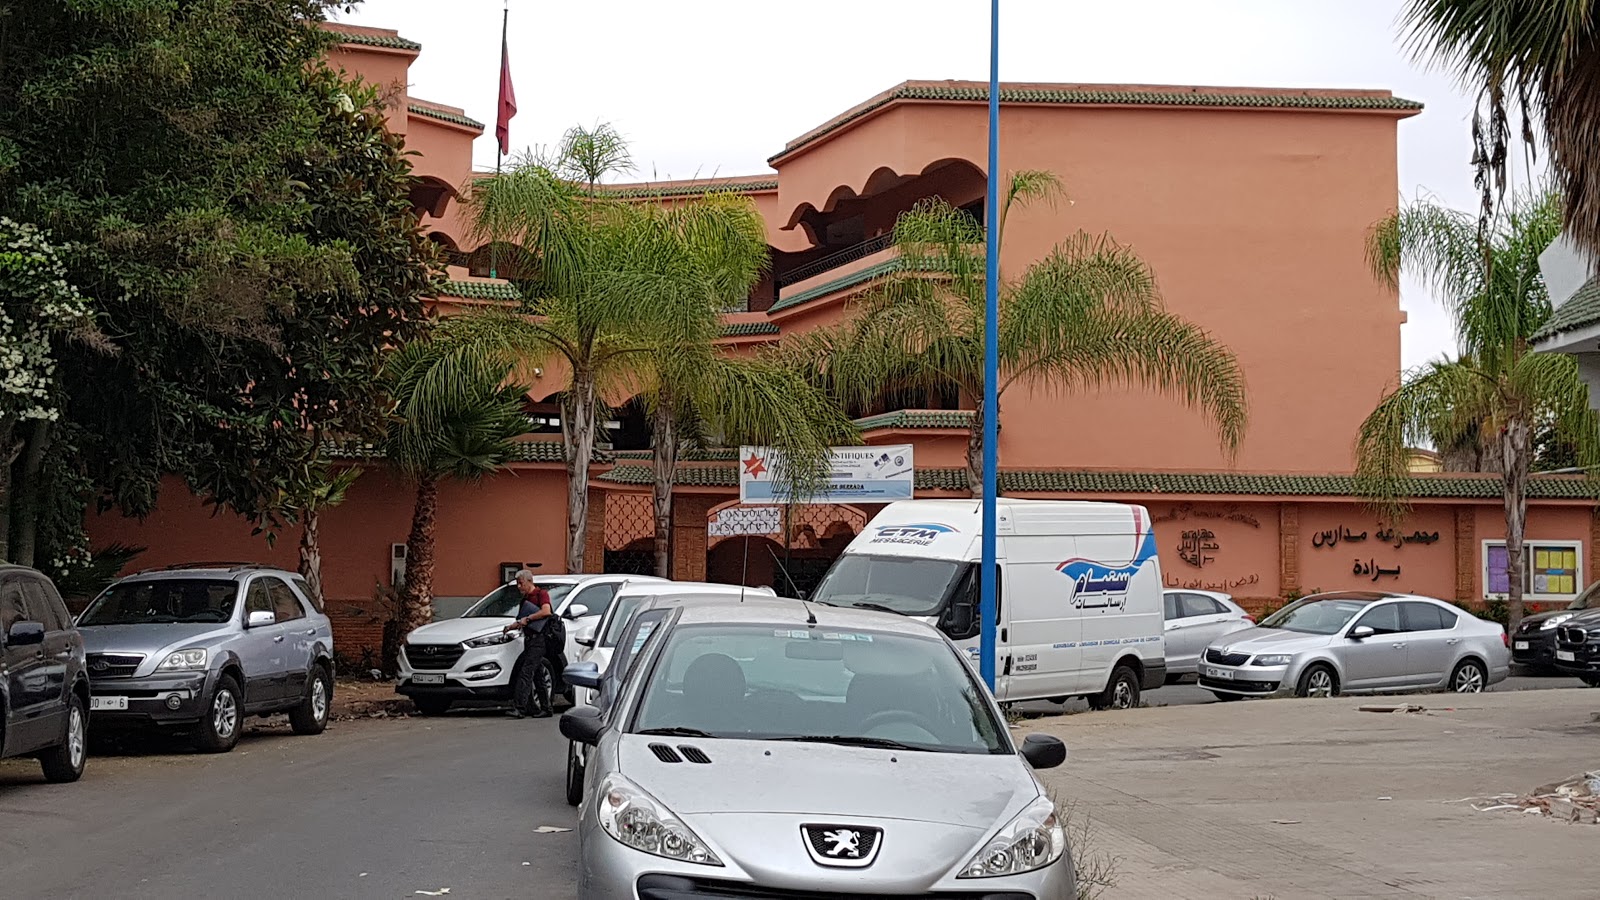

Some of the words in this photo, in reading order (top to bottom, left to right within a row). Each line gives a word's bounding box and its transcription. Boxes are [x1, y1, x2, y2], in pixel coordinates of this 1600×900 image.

[820, 452, 874, 460] IENTIFIQUES
[877, 528, 938, 540] CTM
[1311, 524, 1368, 548] مدارس
[869, 538, 931, 547] MESSAGERIE
[1353, 558, 1401, 581] برادة
[119, 698, 125, 708] 6
